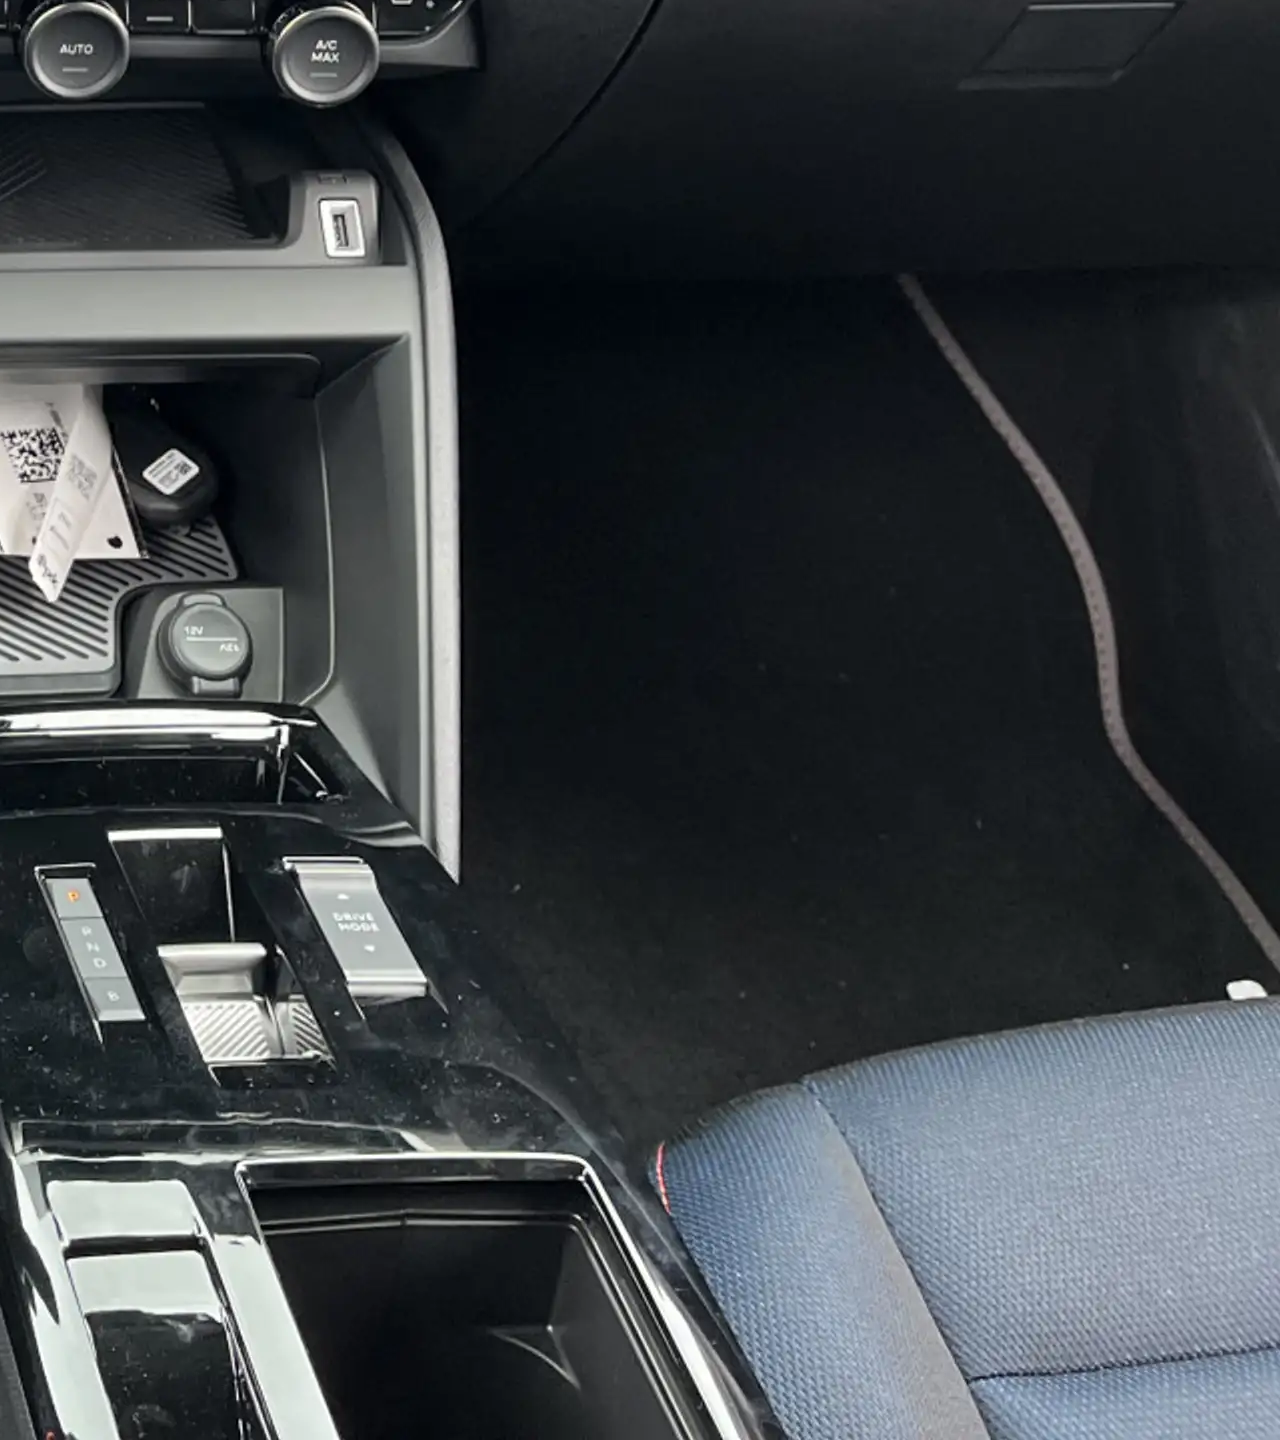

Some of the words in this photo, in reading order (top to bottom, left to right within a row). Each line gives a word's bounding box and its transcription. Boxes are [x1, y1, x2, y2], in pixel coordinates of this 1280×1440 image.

[59, 43, 94, 56] AUTO
[315, 39, 338, 51] A/C
[310, 51, 340, 64] MAX
[183, 625, 204, 636] 12V
[67, 889, 80, 903] P
[332, 911, 374, 922] DRIVE
[337, 921, 380, 933] MODE
